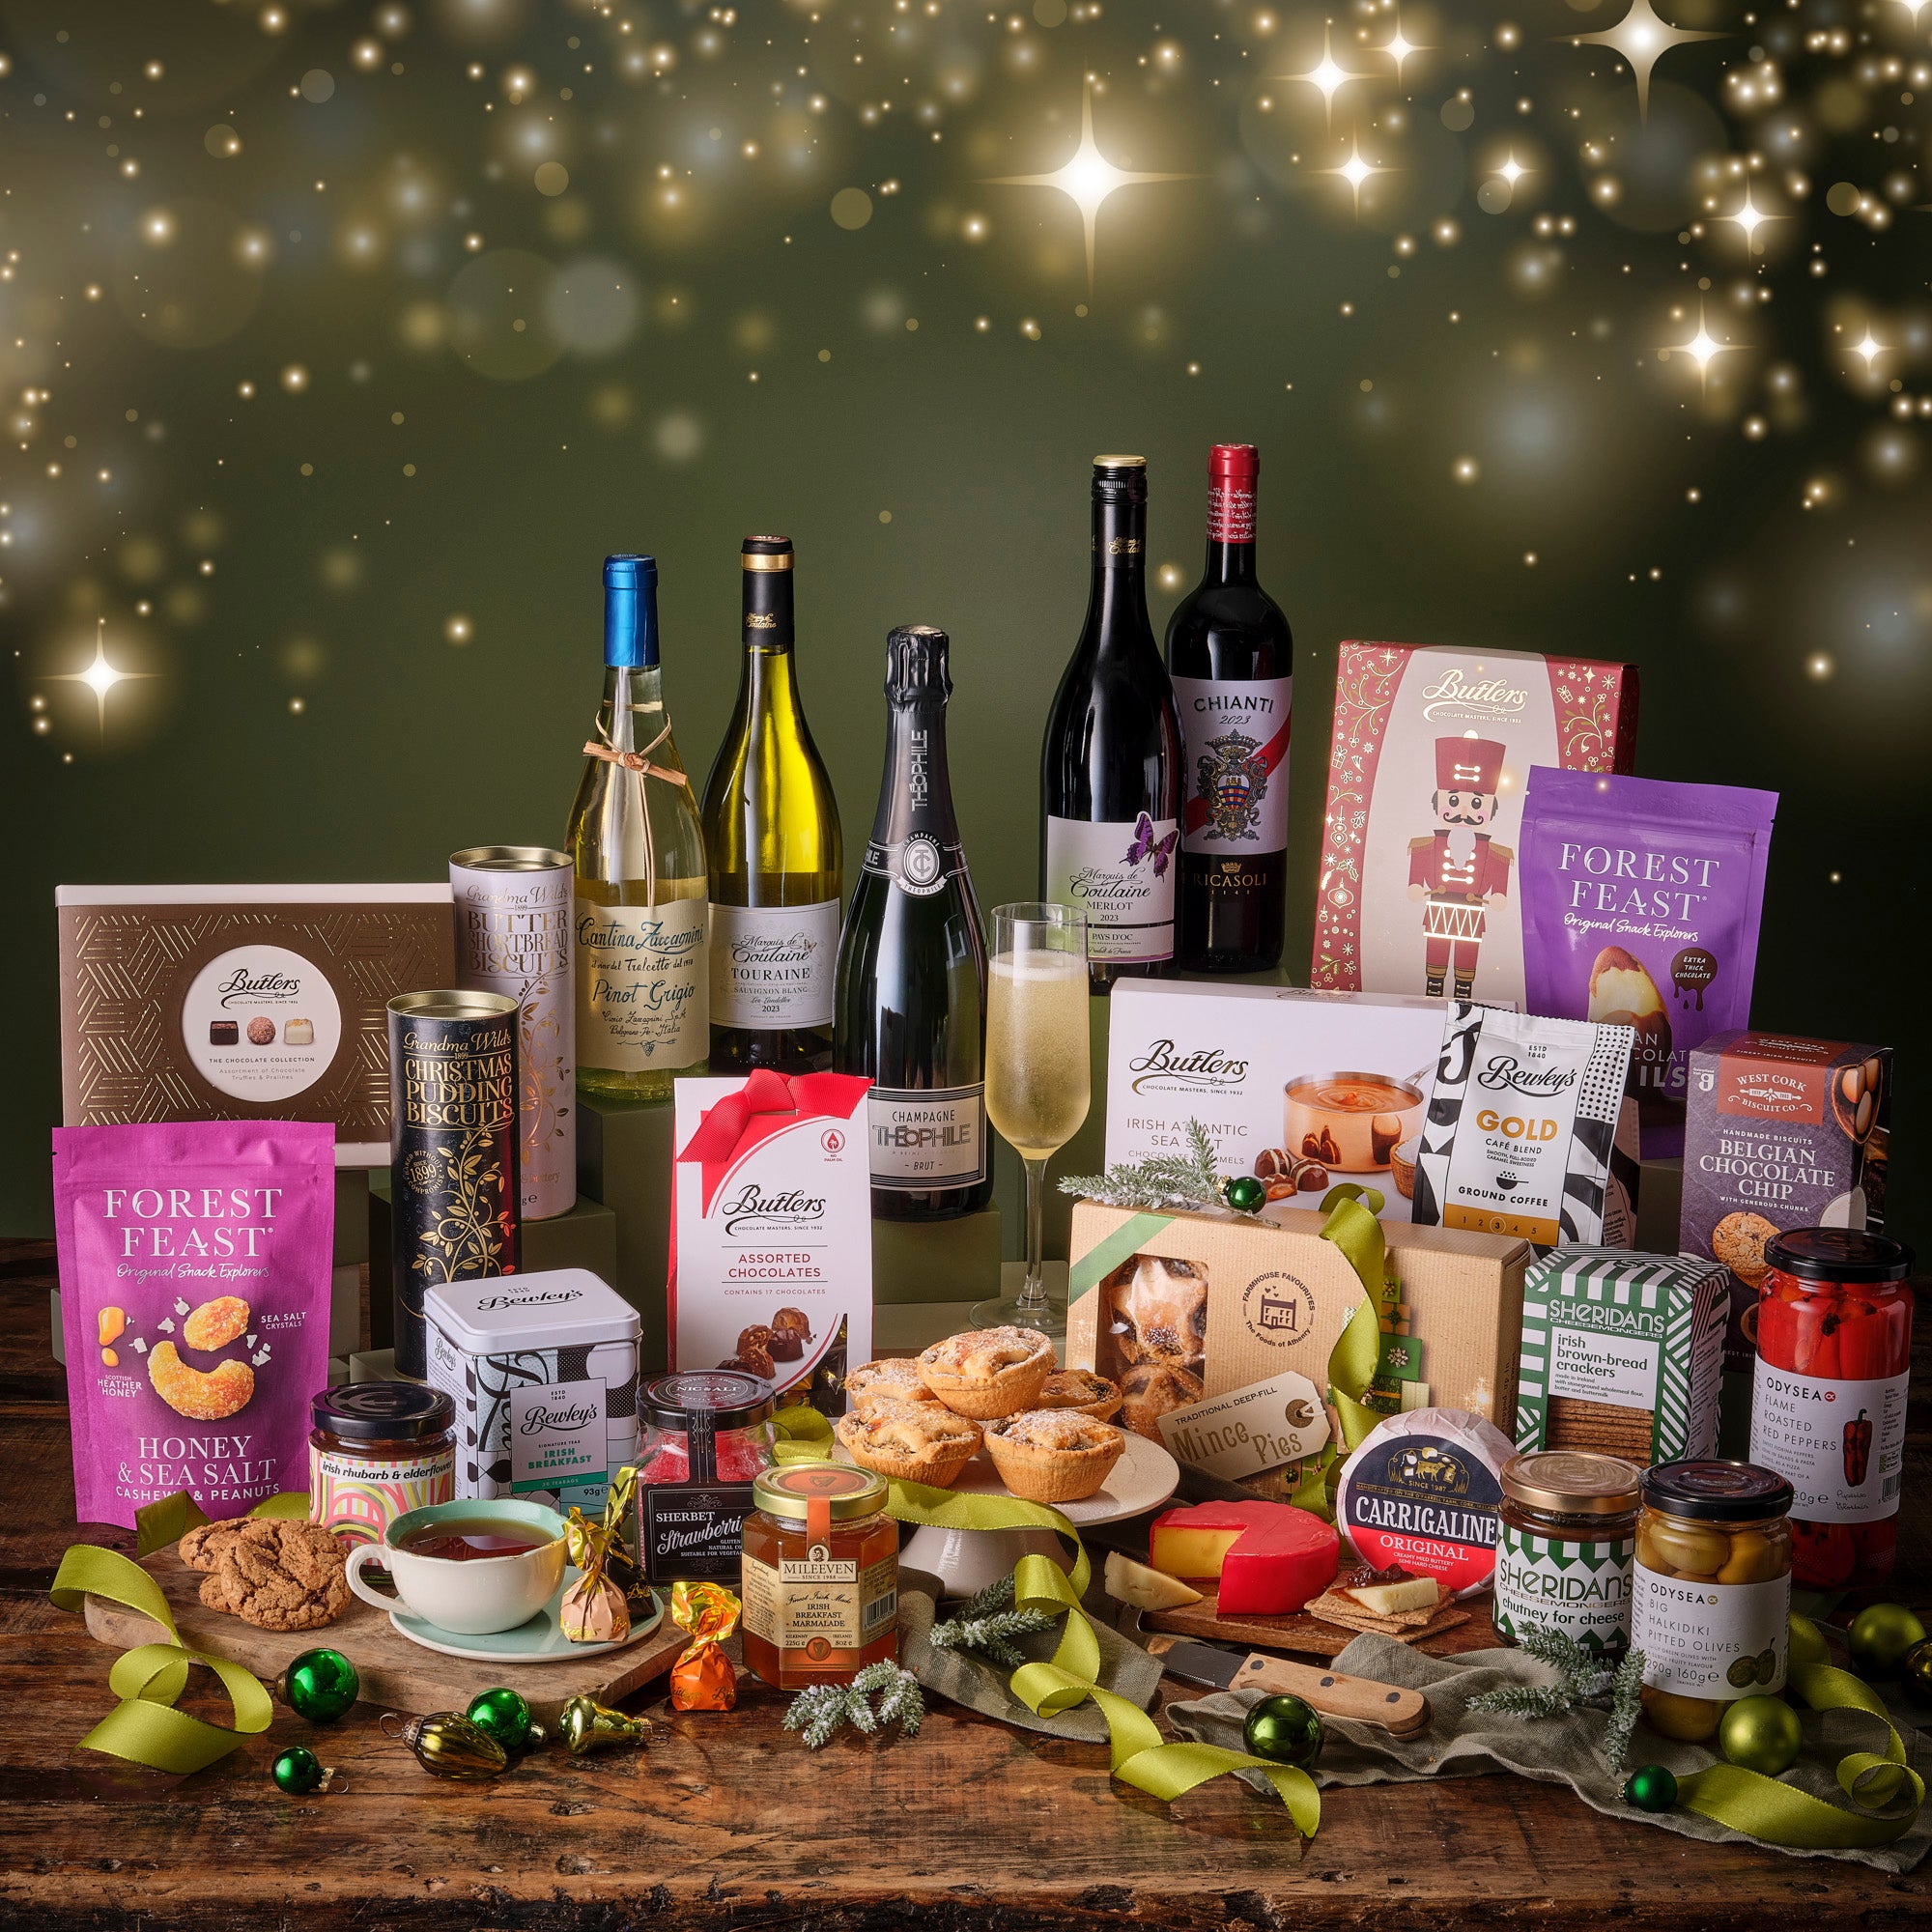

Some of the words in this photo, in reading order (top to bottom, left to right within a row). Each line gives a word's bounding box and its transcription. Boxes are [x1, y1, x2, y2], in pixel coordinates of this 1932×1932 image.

[1422, 668, 1528, 711] Butlers
[1193, 696, 1274, 714] CHIANTI
[1218, 715, 1251, 724] 2023
[1557, 842, 1719, 888] FOREST
[1193, 872, 1266, 886] RICASOLI
[466, 884, 526, 903] Grandma
[1568, 879, 1700, 922] FEAST
[1086, 900, 1134, 911] MERLOT
[468, 910, 568, 932] BUTTER
[573, 912, 635, 950] Cantina
[1564, 912, 1616, 934] Original
[1616, 919, 1652, 937] Snack
[1654, 923, 1699, 943] Explorers
[468, 929, 568, 952] SHORTBREAD
[469, 949, 568, 974] BISCUITS
[1683, 955, 1707, 964] EXTRA
[218, 967, 300, 1000] Butlers
[731, 967, 810, 980] TOURAINE
[592, 979, 647, 1003] Pinot
[644, 980, 696, 1010] Grigio
[404, 1032, 469, 1052] Grandma
[470, 1029, 512, 1051] Wild's
[405, 1053, 512, 1082] CHRISTMAS
[1129, 1039, 1249, 1082] Butlers
[1477, 1055, 1577, 1097] Bewley's
[1736, 1073, 1769, 1086] WEST
[1772, 1074, 1807, 1093] CORK
[406, 1076, 513, 1104] PUDDING
[407, 1098, 513, 1126] BISCUITS
[893, 1110, 955, 1122] CHAMPAGNE
[1742, 1098, 1780, 1112] BISCUIT
[1126, 1118, 1165, 1131] IRISH
[1476, 1109, 1558, 1142] GOLD
[1151, 1135, 1180, 1148] SEA
[1485, 1138, 1511, 1151] CAFÉ
[1513, 1144, 1543, 1155] BLEND
[1723, 1128, 1771, 1140] HANDMADE
[1774, 1135, 1813, 1145] BISCUITS
[1719, 1138, 1817, 1166] BELGIAN
[410, 1164, 437, 1183] 1899
[914, 1161, 934, 1170] BRUT
[1699, 1154, 1835, 1187] CHOCOLATE
[408, 1172, 445, 1195] COMPROMISE
[1738, 1179, 1794, 1201] CHIP
[102, 1188, 282, 1218] FOREST
[723, 1183, 826, 1221] Butlers
[1458, 1186, 1506, 1202] GROUND
[1510, 1195, 1548, 1208] COFFEE
[1719, 1195, 1739, 1204] WITH
[1740, 1199, 1777, 1208] GENEROUS
[1780, 1204, 1809, 1212] CHUNKS
[120, 1227, 266, 1257] FEAST
[738, 1254, 811, 1264] ASSORTED
[117, 1263, 176, 1284] Original
[177, 1263, 217, 1278] Snack
[219, 1263, 270, 1282] Explorers
[728, 1267, 821, 1278] CHOCOLATES
[477, 1289, 583, 1312] Bewley's
[1242, 1271, 1280, 1302] FARMHOUSE
[1282, 1272, 1316, 1311] FAVOURITES
[261, 1315, 280, 1323] SEA
[283, 1311, 307, 1321] SALT
[266, 1320, 302, 1330] CRYSTALS
[1245, 1320, 1256, 1334] The
[1255, 1332, 1276, 1347] Foods
[1287, 1328, 1311, 1347] Athenry
[1549, 1318, 1663, 1339] CHEESEMONGERS
[1557, 1334, 1586, 1349] irish
[1556, 1361, 1615, 1378] crackers
[1557, 1347, 1648, 1371] brown-bread
[98, 1378, 142, 1390] HEATHER
[101, 1388, 137, 1398] HONEY
[1766, 1377, 1822, 1401] ODYSEA
[1175, 1403, 1233, 1426] TRADITIONAL
[1234, 1386, 1278, 1407] DEEP-FILL
[1765, 1394, 1796, 1412] FLAME
[521, 1403, 598, 1435] Bewley's
[1764, 1409, 1812, 1432] ROASTED
[137, 1435, 252, 1459] HONEY
[1171, 1420, 1251, 1463] Mince
[1251, 1432, 1303, 1465] Pies
[1763, 1425, 1779, 1439] RED
[1784, 1433, 1837, 1451] PEPPERS
[528, 1455, 592, 1470] BREAKFAST
[544, 1448, 576, 1459] IRISH
[118, 1462, 133, 1484] &
[139, 1463, 196, 1486] SEA
[203, 1459, 276, 1486] SALT
[323, 1462, 340, 1475] irish
[343, 1467, 388, 1480] rhubarb
[404, 1460, 453, 1479] elderflower
[193, 1491, 203, 1501] &
[211, 1483, 280, 1501] PEANUTS
[1408, 1480, 1429, 1490] SINCE
[1431, 1483, 1447, 1492] 1987
[656, 1511, 716, 1522] SHERBET
[1355, 1495, 1496, 1546] CARRIGALINE
[1379, 1534, 1469, 1561] ORIGINAL
[783, 1563, 854, 1575] MILEEVEN
[1394, 1551, 1415, 1560] CREAMY
[1430, 1557, 1454, 1567] BUTTERY
[1429, 1563, 1448, 1572] CHEESE
[1500, 1581, 1631, 1608] CHEESEMONGERS
[1650, 1582, 1705, 1605] ODYSEA
[1503, 1597, 1548, 1623] chutney
[1552, 1610, 1575, 1624] for
[1579, 1611, 1625, 1625] cheese
[1649, 1599, 1668, 1612] BIG
[1649, 1614, 1710, 1635] HALKIDIKI
[1648, 1630, 1686, 1648] PITTED
[1692, 1640, 1740, 1653] OLIVES
[1647, 1659, 1672, 1678] 290g
[1677, 1667, 1706, 1683] 160g
